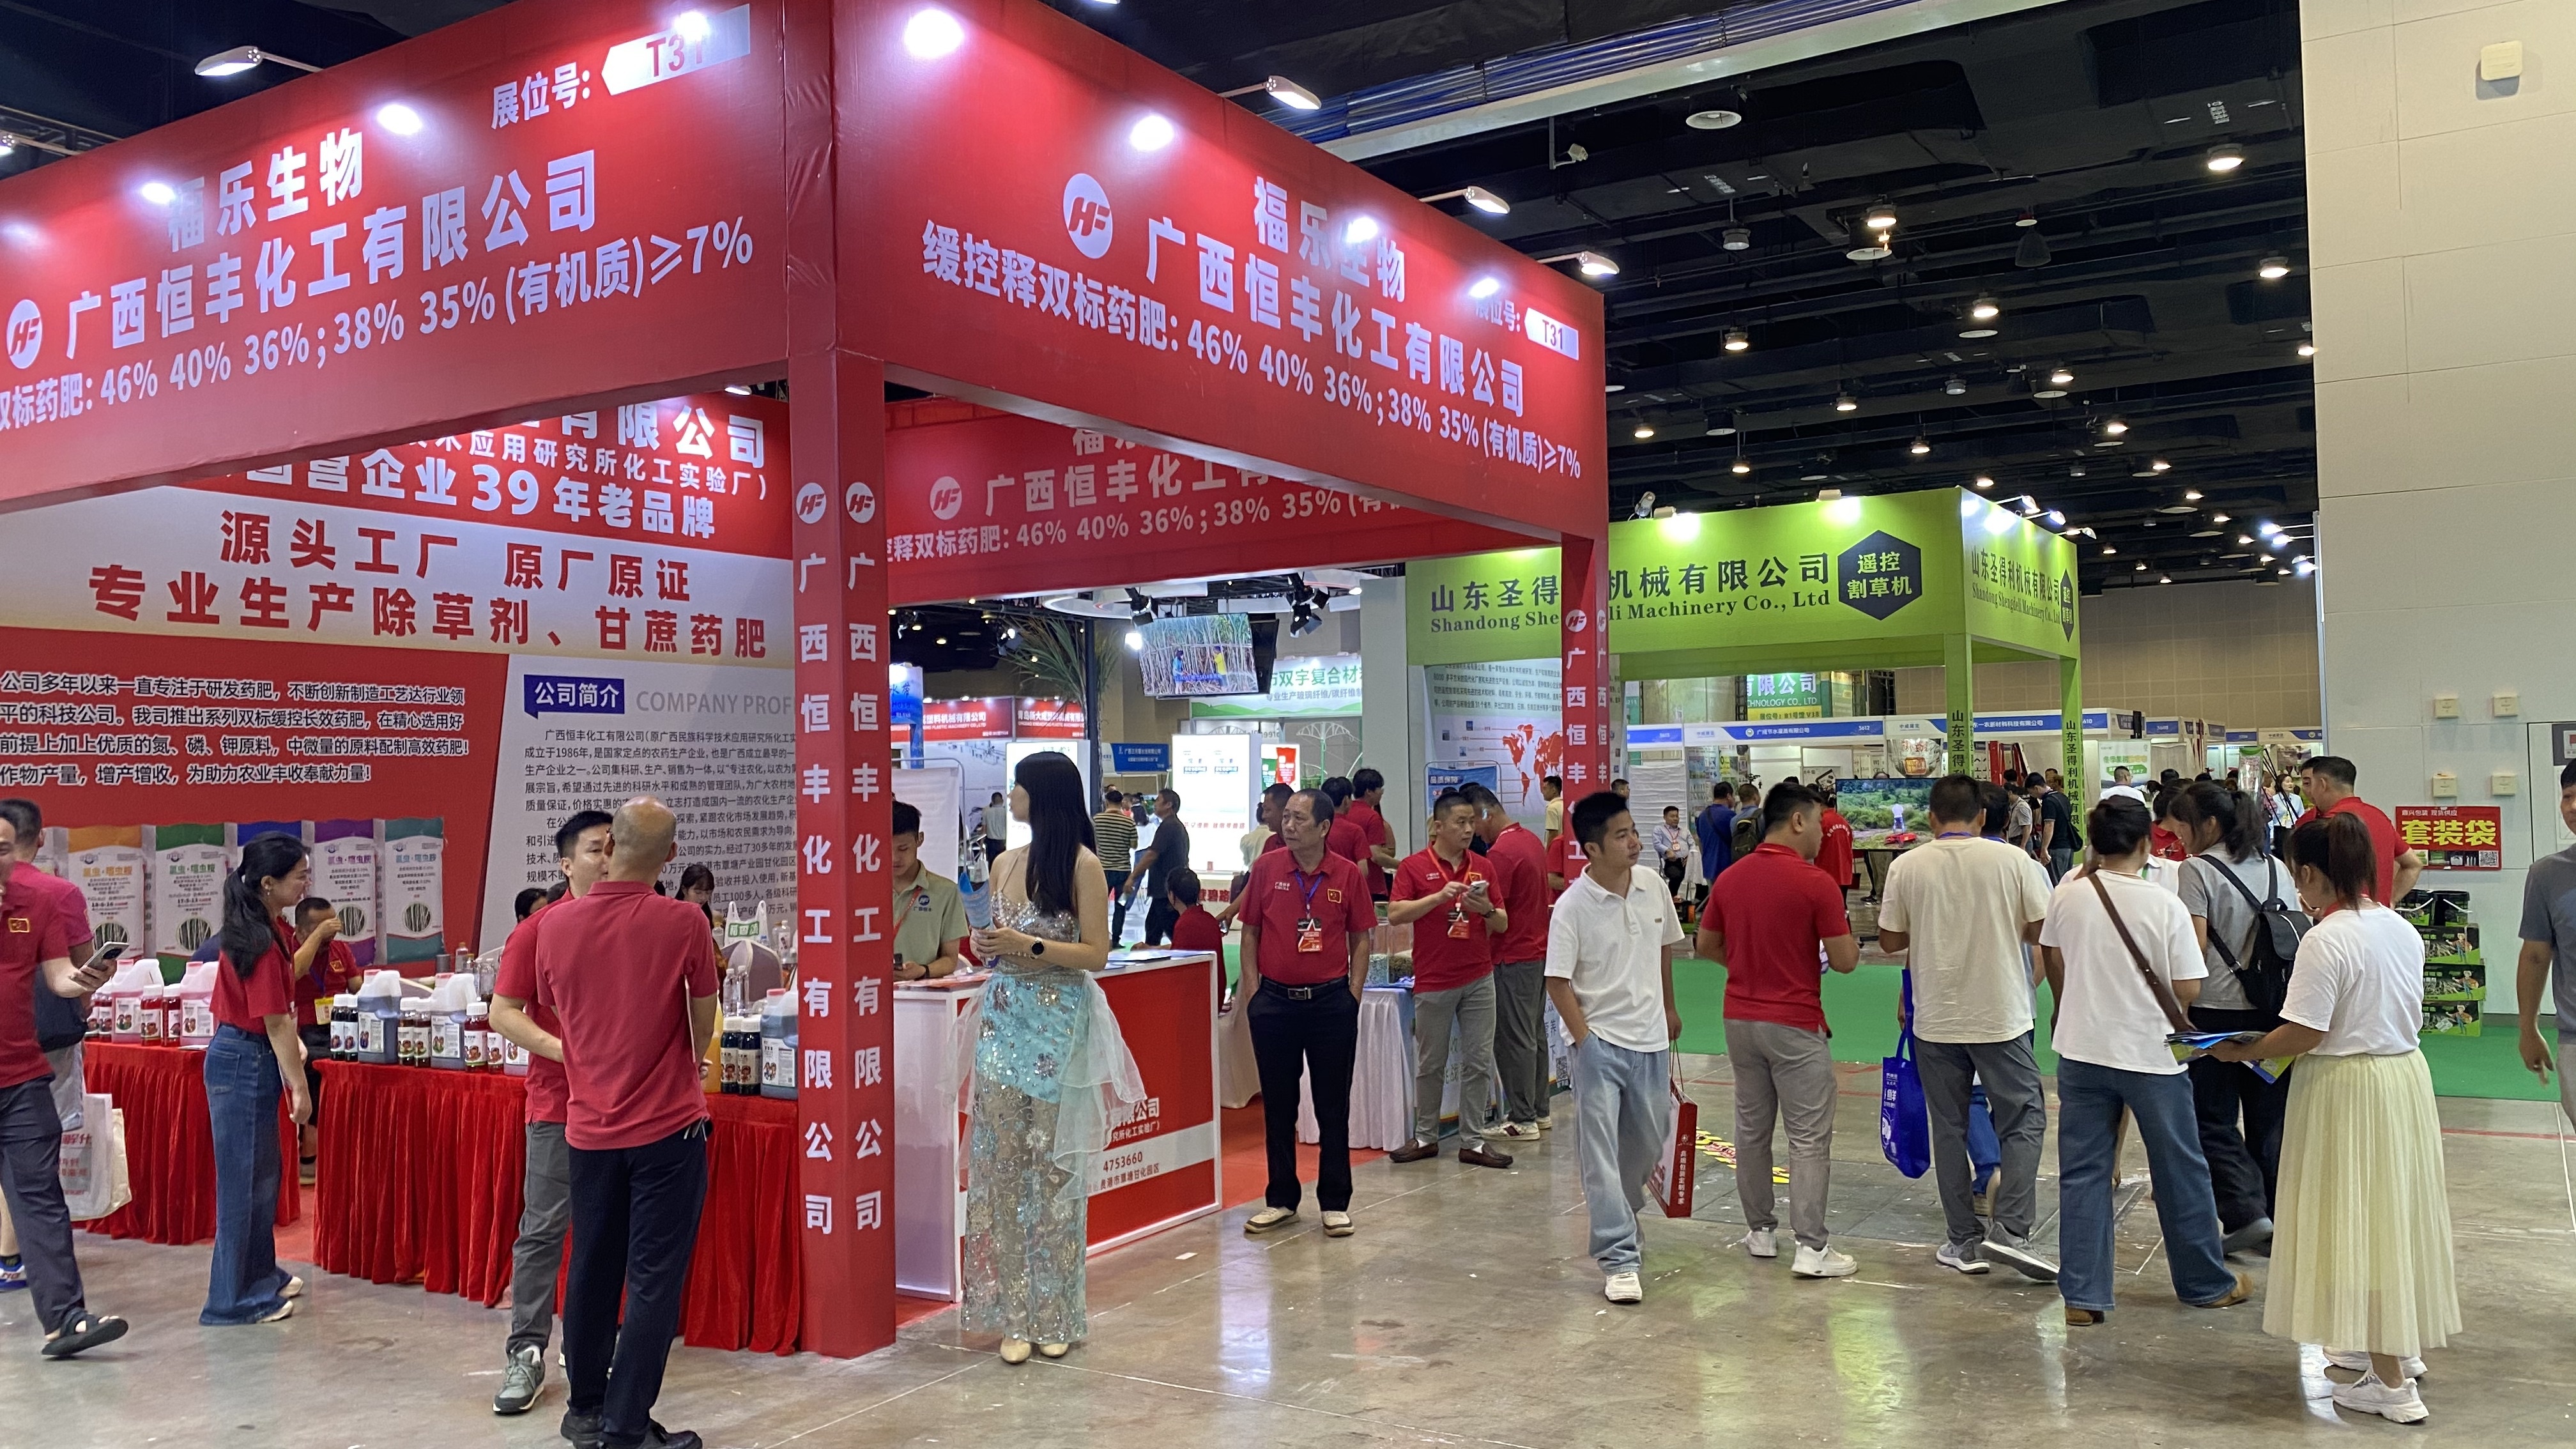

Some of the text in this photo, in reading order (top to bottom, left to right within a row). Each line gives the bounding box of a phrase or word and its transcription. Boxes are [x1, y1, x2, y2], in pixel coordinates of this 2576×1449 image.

[169, 128, 363, 252] 福乐生物
[66, 150, 595, 359] 广西恒丰化工有限公司
[1254, 176, 1406, 302] 福乐生物
[101, 359, 158, 406] 46%
[170, 342, 231, 391] 40%
[420, 277, 496, 335] 35%
[1147, 217, 1524, 418] 广西恒丰化工有限公司
[1542, 319, 1563, 350] T31
[1187, 319, 1248, 375] 46%
[1258, 342, 1314, 395] 40%
[1439, 405, 1479, 449] 35%
[220, 510, 690, 602] 源头工厂 原厂原证
[1017, 521, 1067, 546] 46%
[1077, 514, 1129, 542] 40%
[1282, 489, 1342, 519] 35%
[1857, 551, 1901, 574] 遥控
[89, 564, 765, 659] 专业生产除草剂、甘蔗药肥
[1431, 615, 1520, 632] Shandong
[1627, 599, 1737, 620] Machinery
[1793, 590, 1830, 608] Ltd
[1847, 577, 1913, 599] 割草机
[1972, 545, 2060, 606] 山东圣得利机械有限公司
[534, 682, 620, 709] 公司简介
[636, 691, 738, 714] COMPANY
[1567, 648, 1587, 860] 广西恒丰工
[2066, 720, 2080, 832] 山东圣得利机械有限
[546, 816, 573, 829] 在公
[2402, 820, 2497, 847] 套装袋
[798, 553, 832, 1235] 广西恒丰化工有限公司
[847, 552, 882, 1230] 广西恒丰化工有限公司
